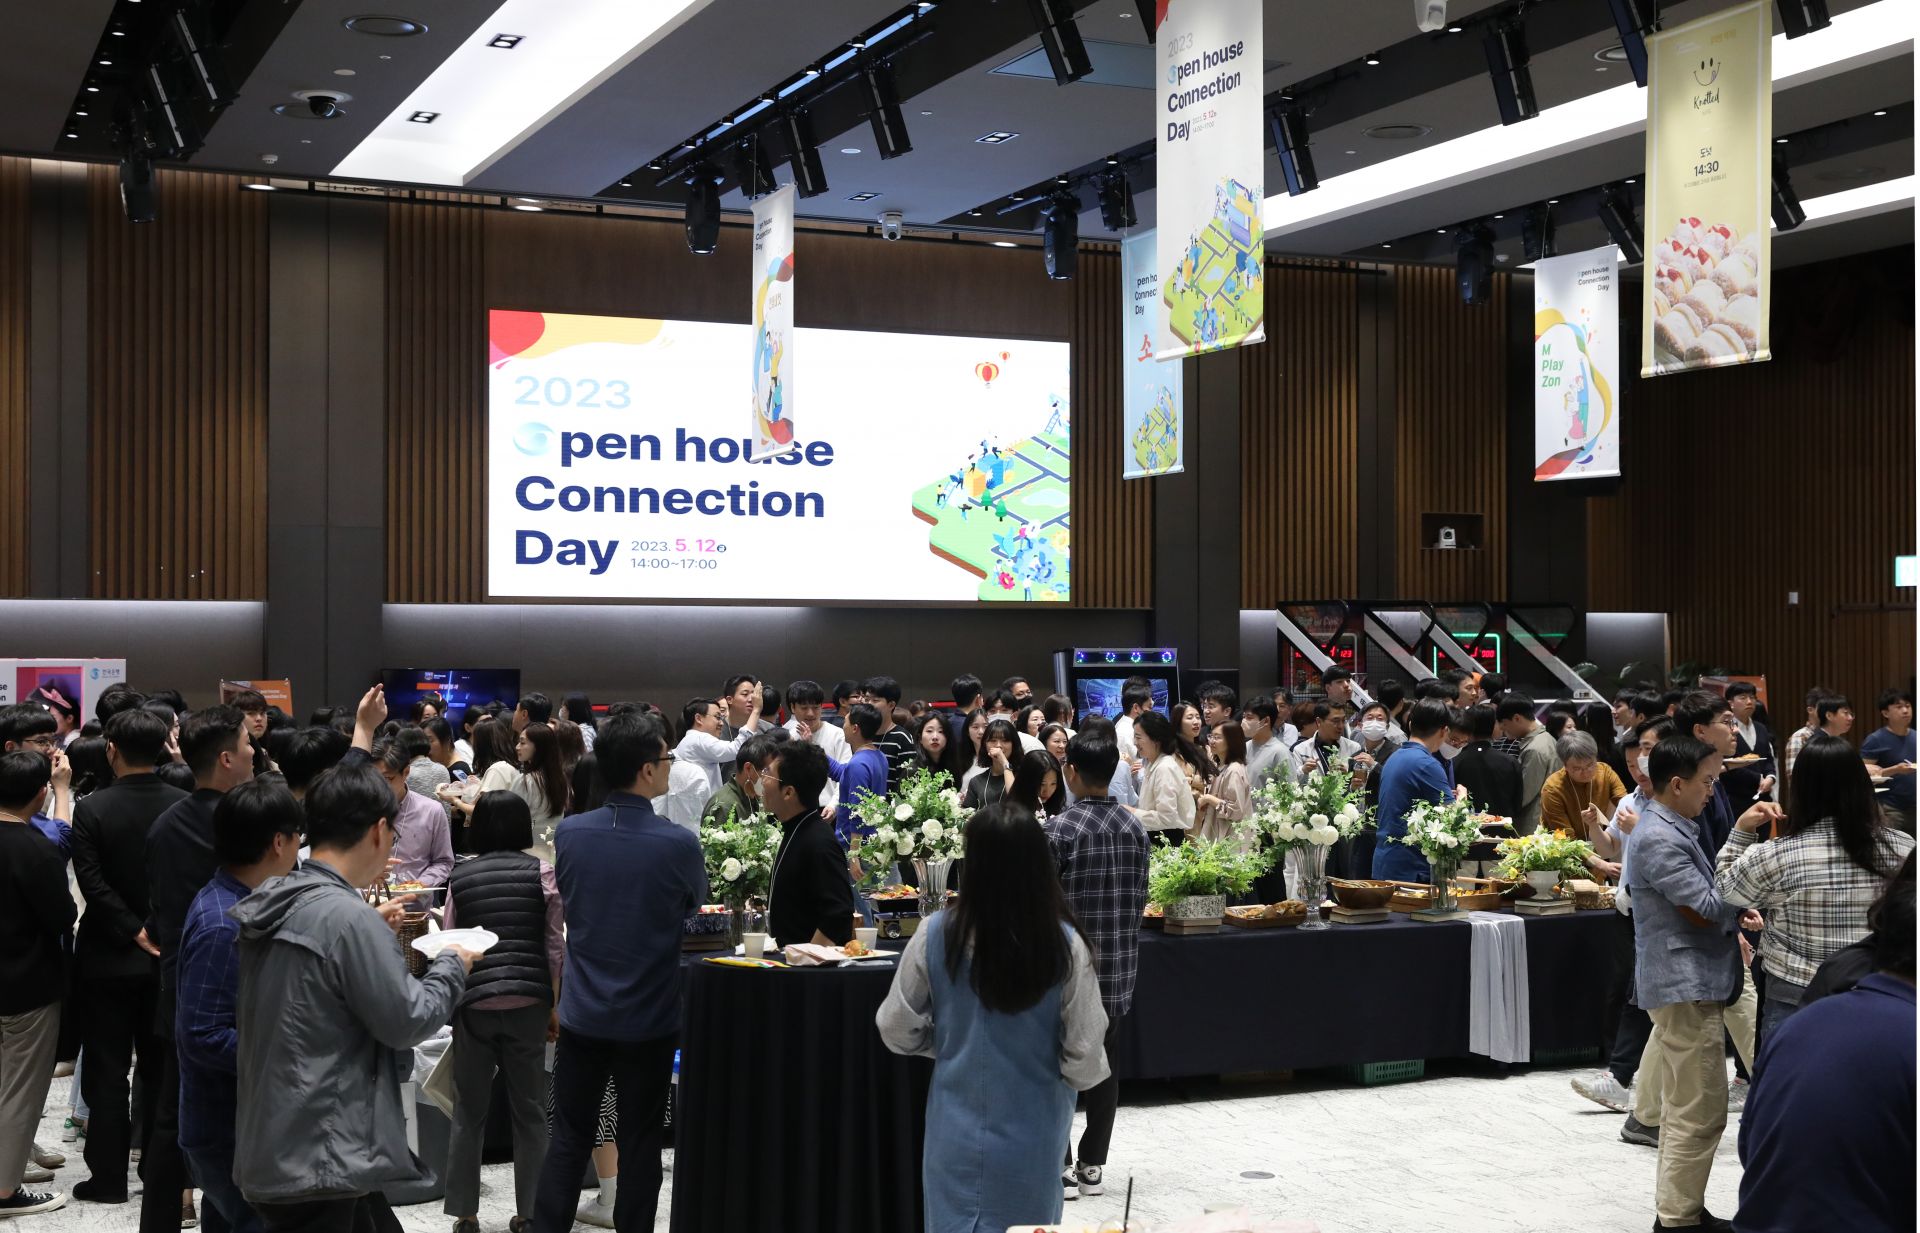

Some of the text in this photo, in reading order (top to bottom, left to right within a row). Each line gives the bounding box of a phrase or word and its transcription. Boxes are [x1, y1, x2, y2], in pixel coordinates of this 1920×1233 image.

[1168, 33, 1193, 58] 2023
[1203, 40, 1244, 71] house
[1168, 71, 1241, 113] Connection
[1693, 88, 1720, 110] Knotted
[1168, 120, 1191, 142] Day
[1694, 160, 1719, 177] 14:30
[1134, 287, 1157, 301] Connec
[1135, 305, 1145, 315] Day
[1542, 344, 1551, 356] M
[1542, 359, 1564, 371] Play
[1542, 376, 1561, 388] Zon
[514, 375, 632, 410] 2023
[515, 475, 825, 518] Connection
[515, 529, 620, 576] Day
[631, 540, 671, 552] 2023.
[630, 557, 718, 570] 14:00~17:00
